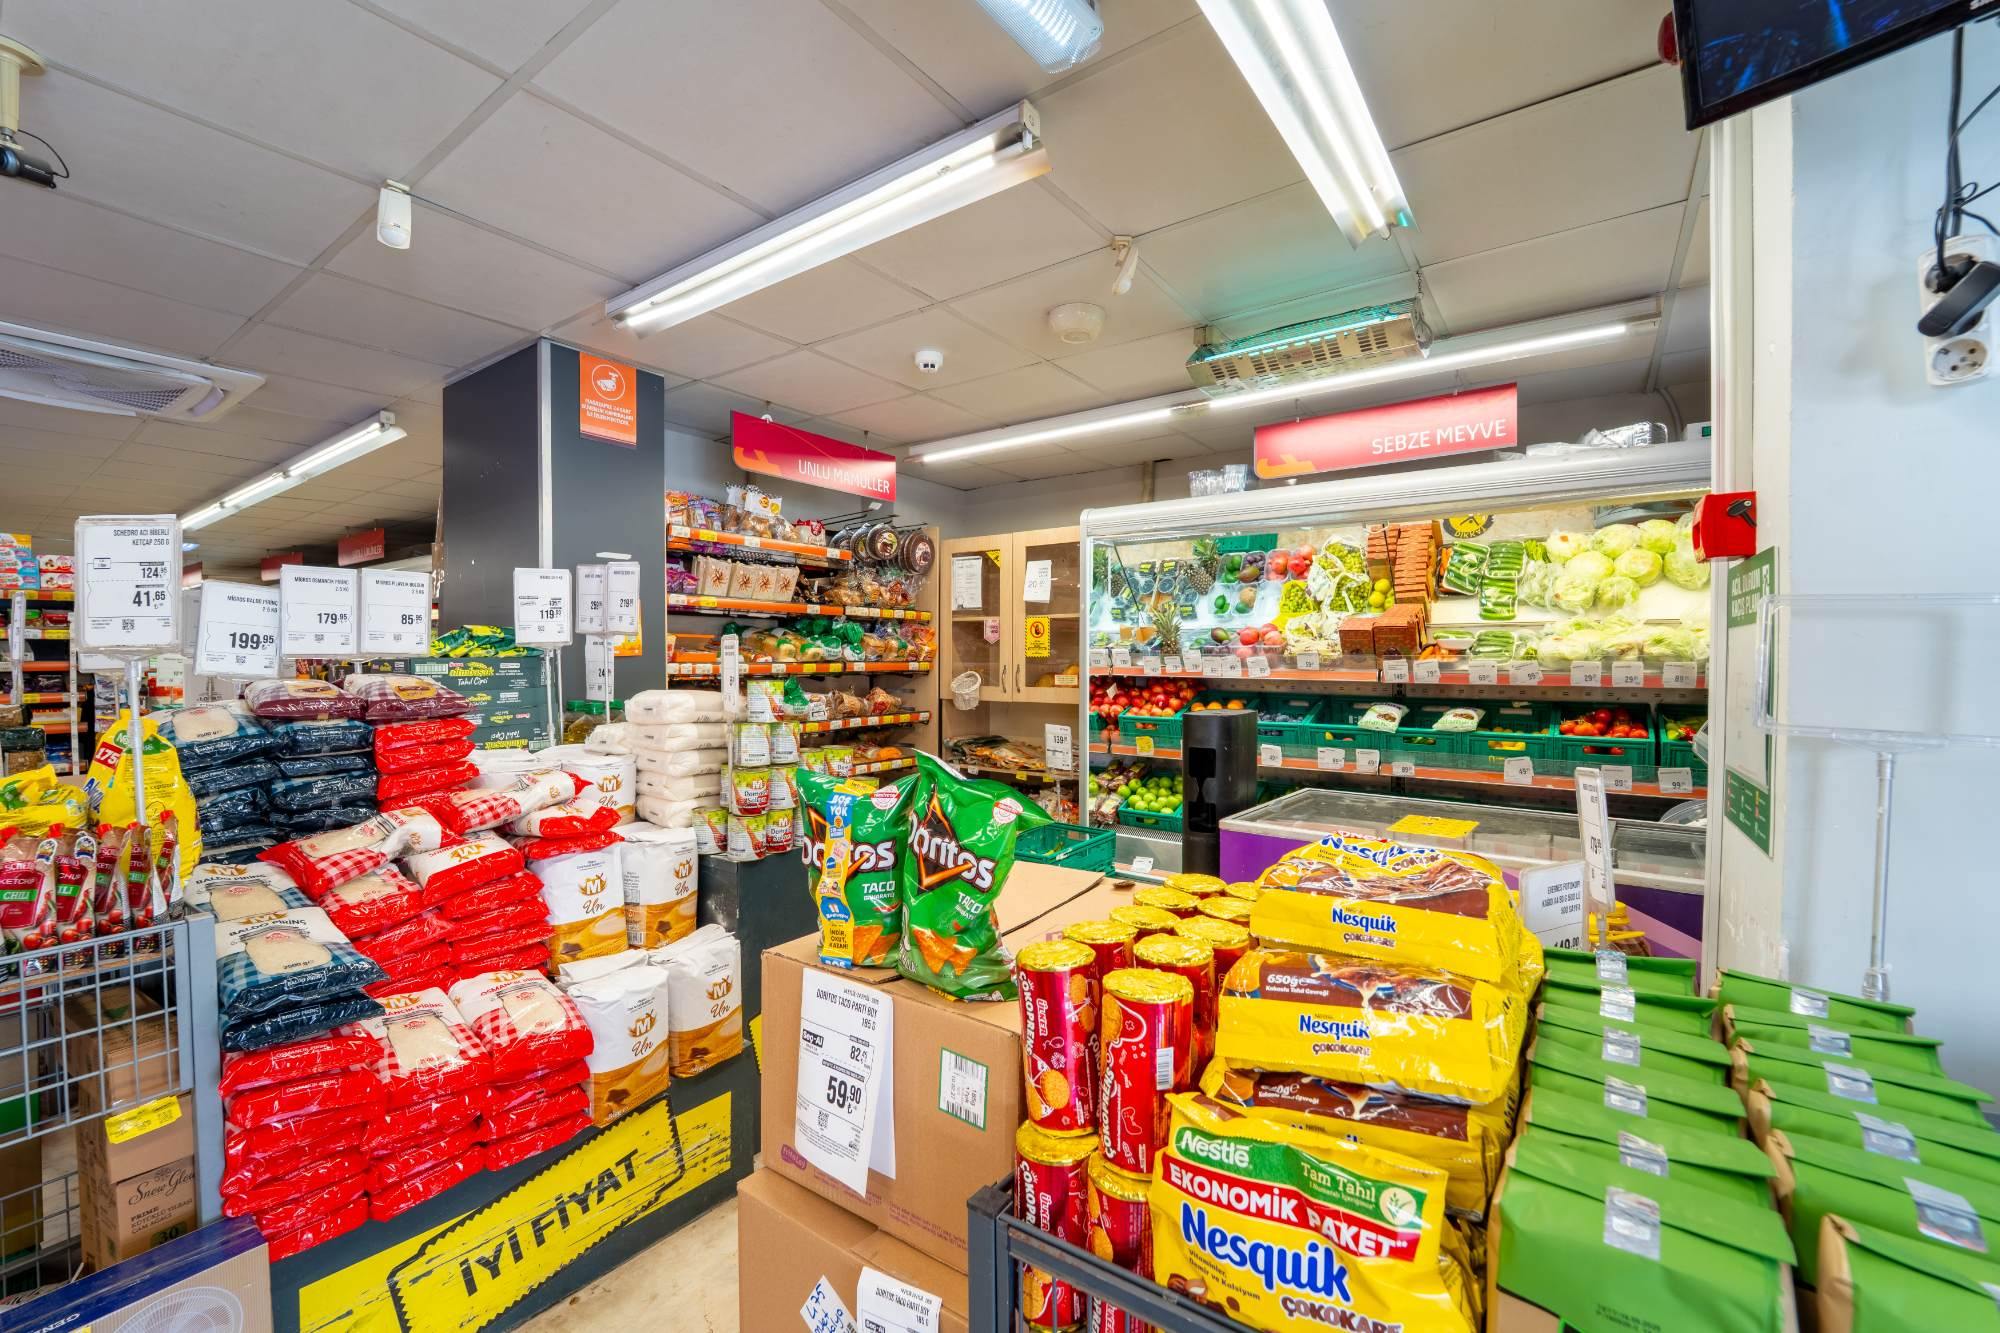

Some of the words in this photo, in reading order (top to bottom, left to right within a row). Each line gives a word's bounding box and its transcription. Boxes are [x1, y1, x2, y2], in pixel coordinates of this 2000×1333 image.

[1372, 430, 1432, 454] SEBZE
[1436, 418, 1507, 445] MEYVE
[798, 459, 830, 480] UNLU
[830, 806, 848, 817] YOK
[862, 881, 895, 893] TACO
[957, 892, 983, 915] TACO
[229, 922, 269, 937] BALDO
[1332, 907, 1397, 933] Nesquik
[1037, 998, 1048, 1037] ÜLKER
[1300, 1015, 1370, 1040] Nesquik
[1181, 1130, 1250, 1169] Nestlé
[1020, 1160, 1036, 1226] ÇOKOPR
[1170, 1162, 1298, 1223] EKONOMİK
[1302, 1162, 1333, 1184] Tam
[1336, 1174, 1376, 1202] Tahıl
[459, 1226, 524, 1297] İYİ
[531, 1148, 638, 1248] FİYAT
[1040, 1192, 1052, 1231] ÜLKER
[1181, 1202, 1351, 1302] Nesquik
